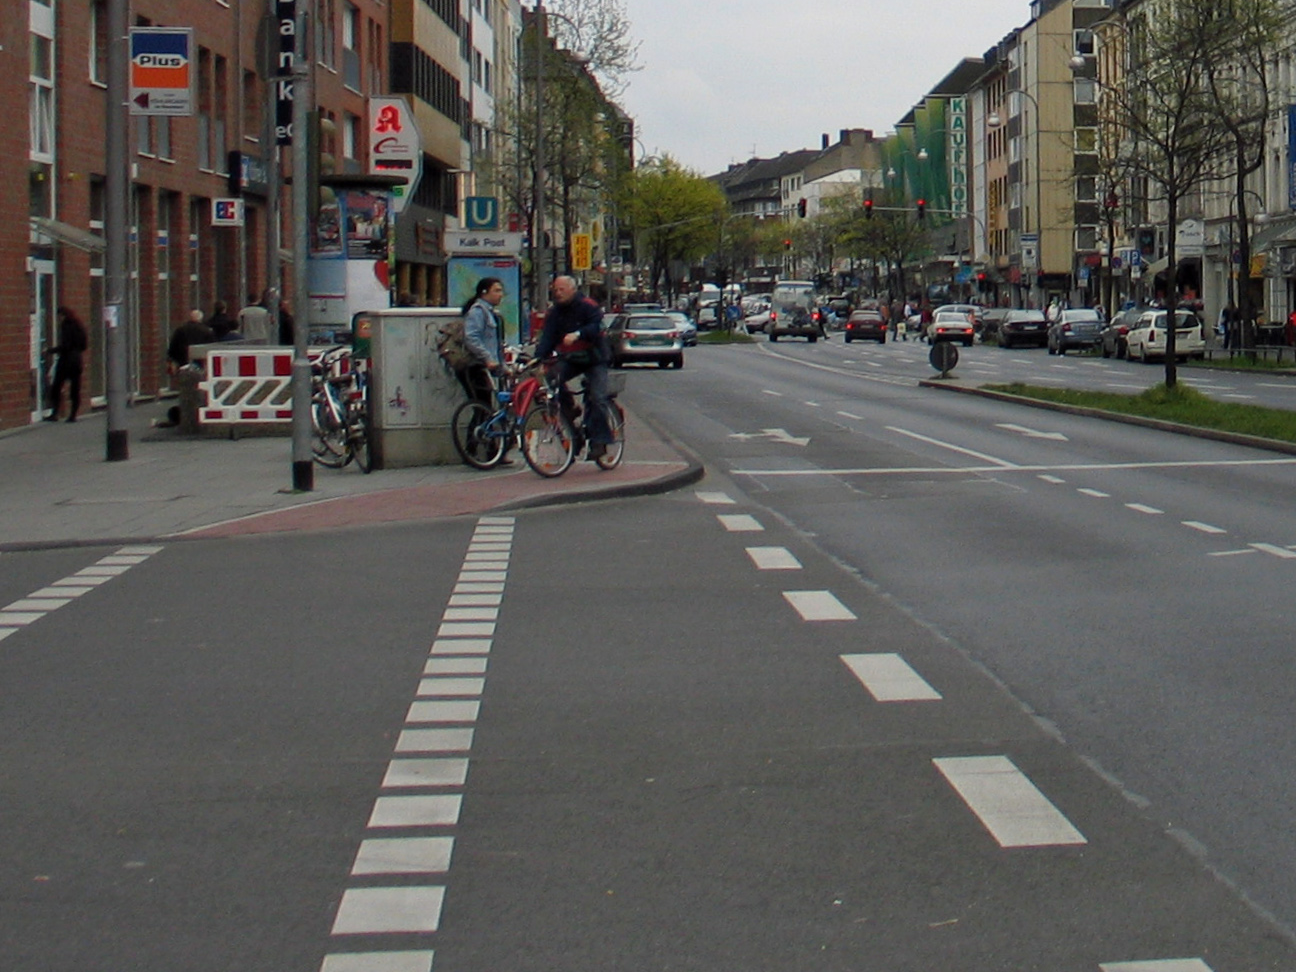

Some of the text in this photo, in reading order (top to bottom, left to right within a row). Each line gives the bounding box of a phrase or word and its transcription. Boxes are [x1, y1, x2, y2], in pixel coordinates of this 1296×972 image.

[140, 55, 181, 66] Plus
[472, 200, 493, 225] U
[459, 238, 505, 247] Kalk Post
